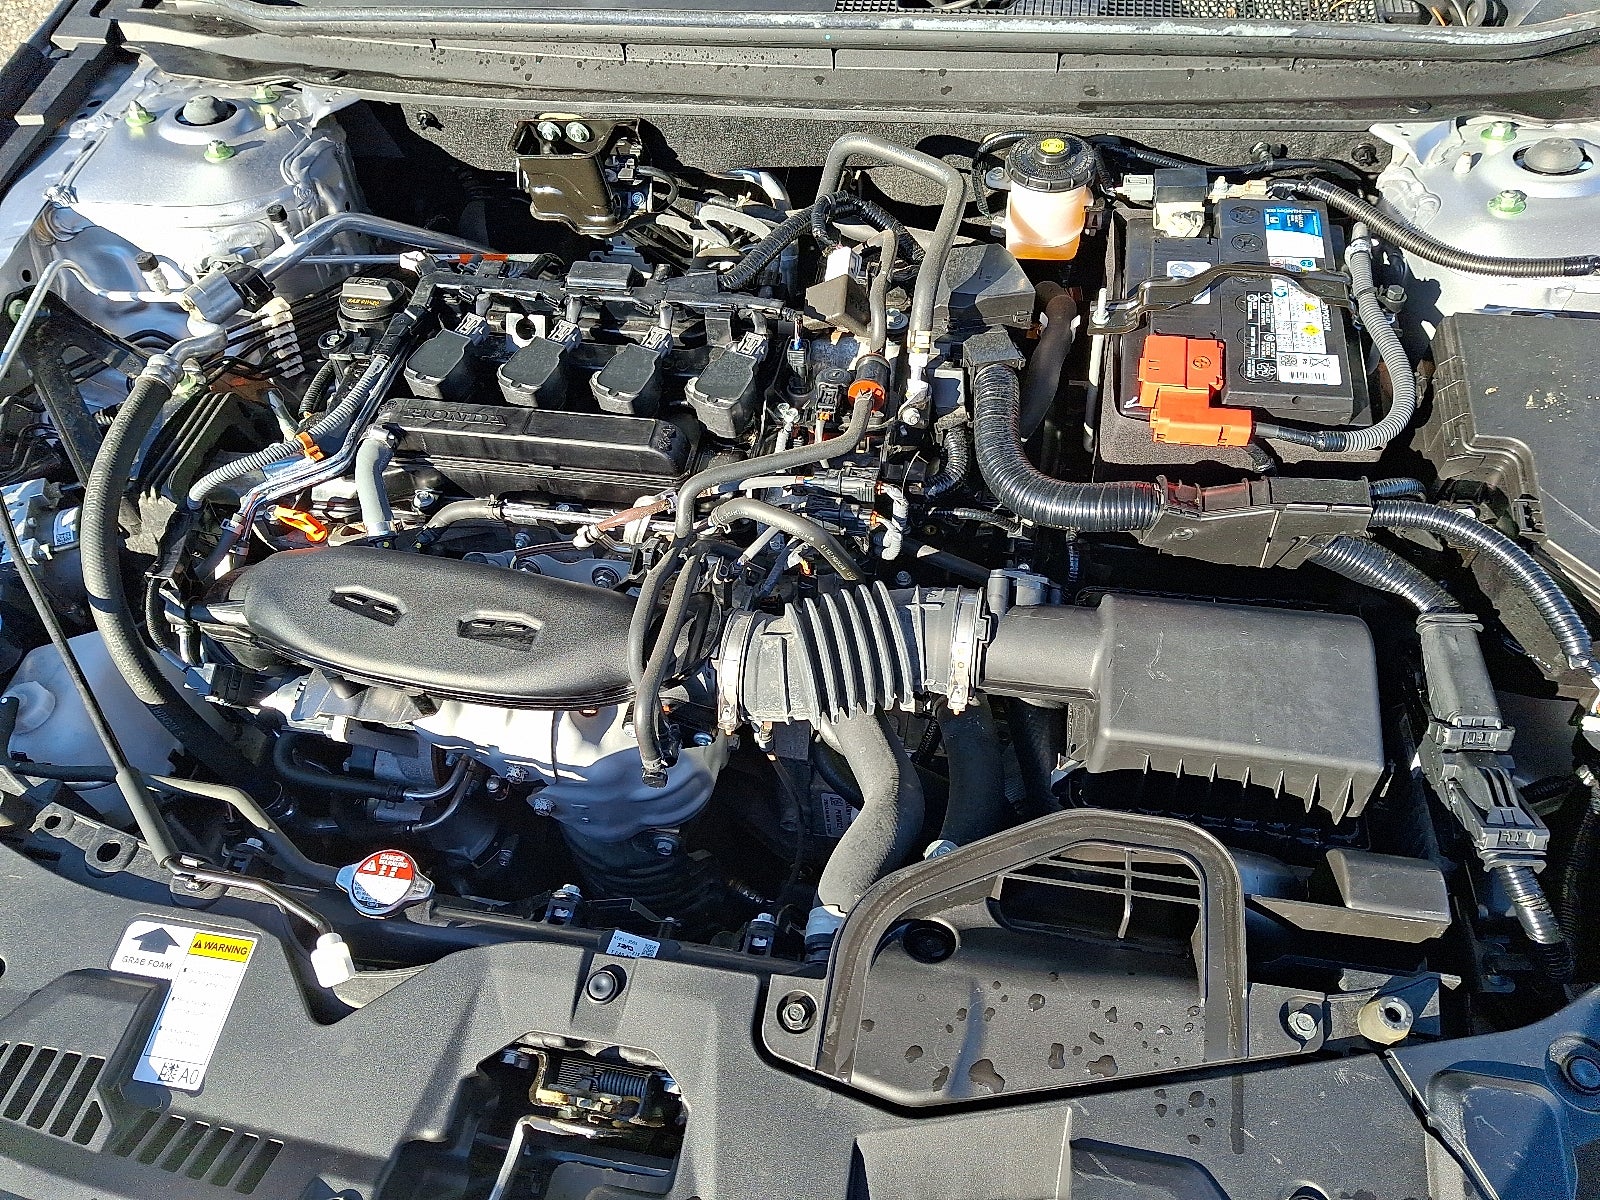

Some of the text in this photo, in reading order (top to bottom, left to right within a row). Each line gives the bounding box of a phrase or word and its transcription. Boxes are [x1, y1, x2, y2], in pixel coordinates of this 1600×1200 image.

[403, 407, 508, 427] HONDA
[203, 941, 248, 956] WARNING
[147, 958, 173, 970] FOAM
